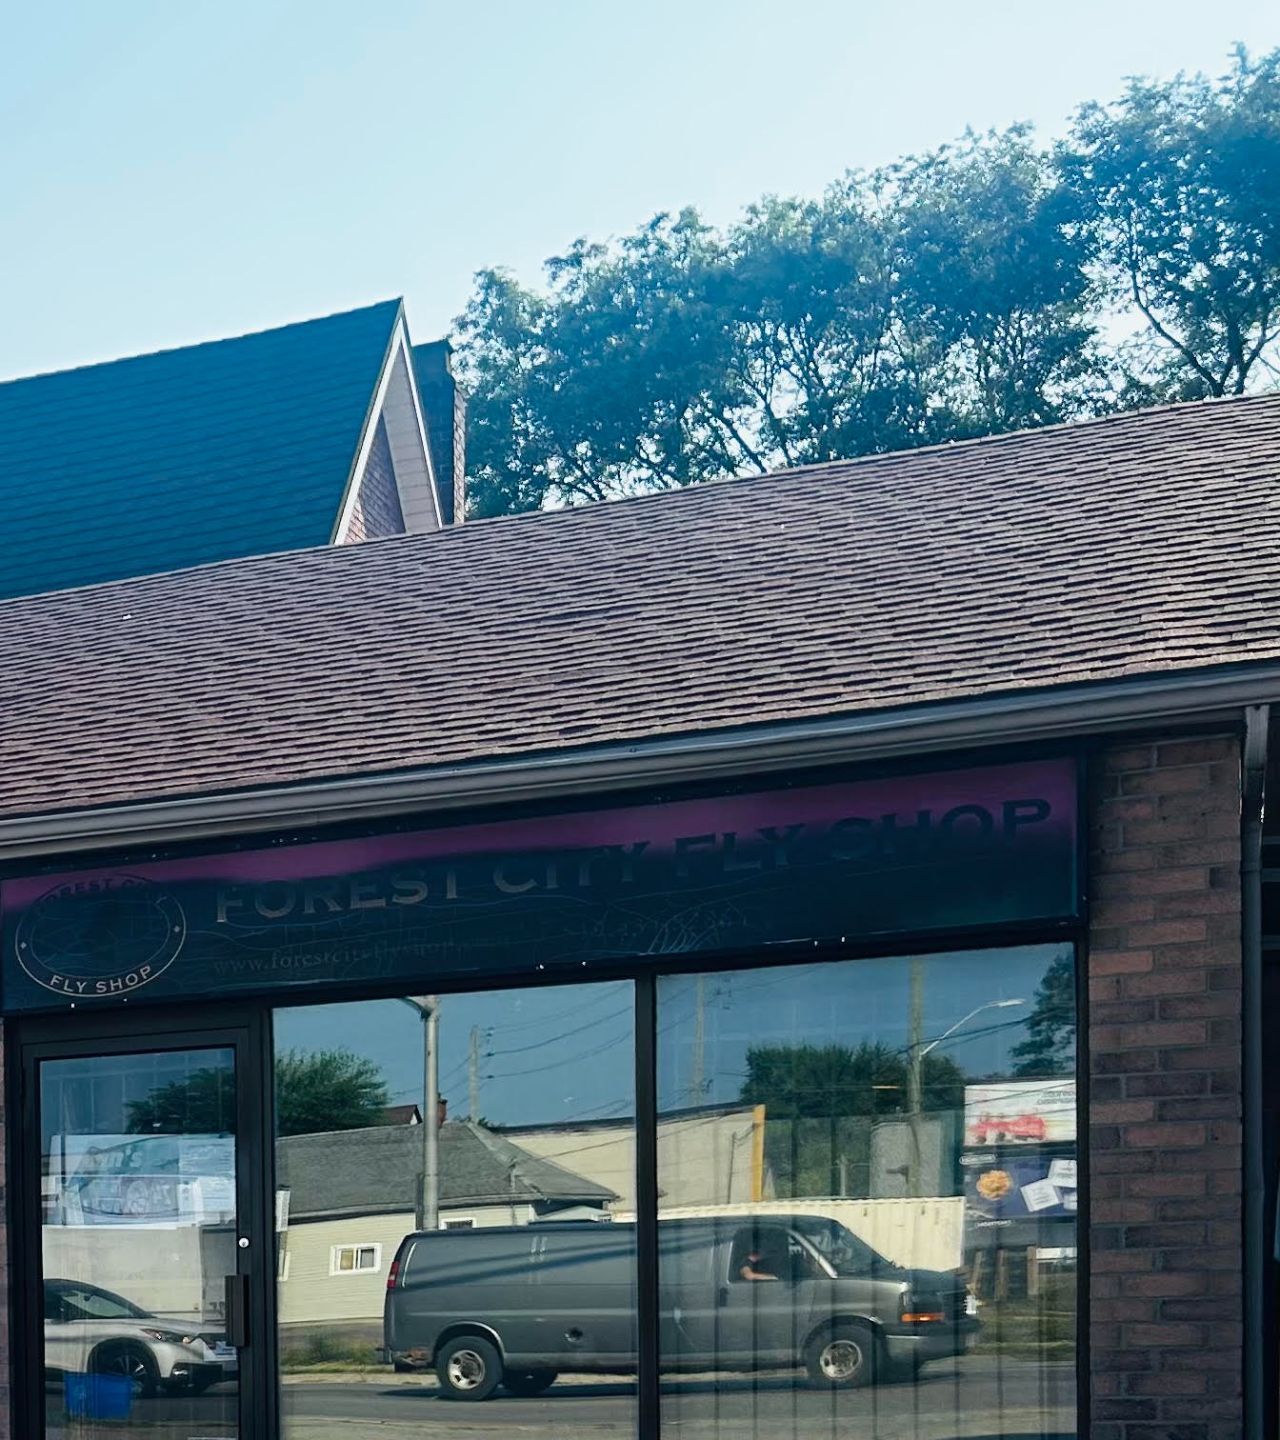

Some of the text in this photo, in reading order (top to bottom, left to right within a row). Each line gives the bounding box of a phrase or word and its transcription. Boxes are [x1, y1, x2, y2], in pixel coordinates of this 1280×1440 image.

[214, 864, 466, 923] FOREST
[492, 841, 651, 894] CITY
[675, 823, 806, 877] FLY
[830, 798, 1052, 861] SHOP
[49, 965, 152, 994] FLY SHOP
